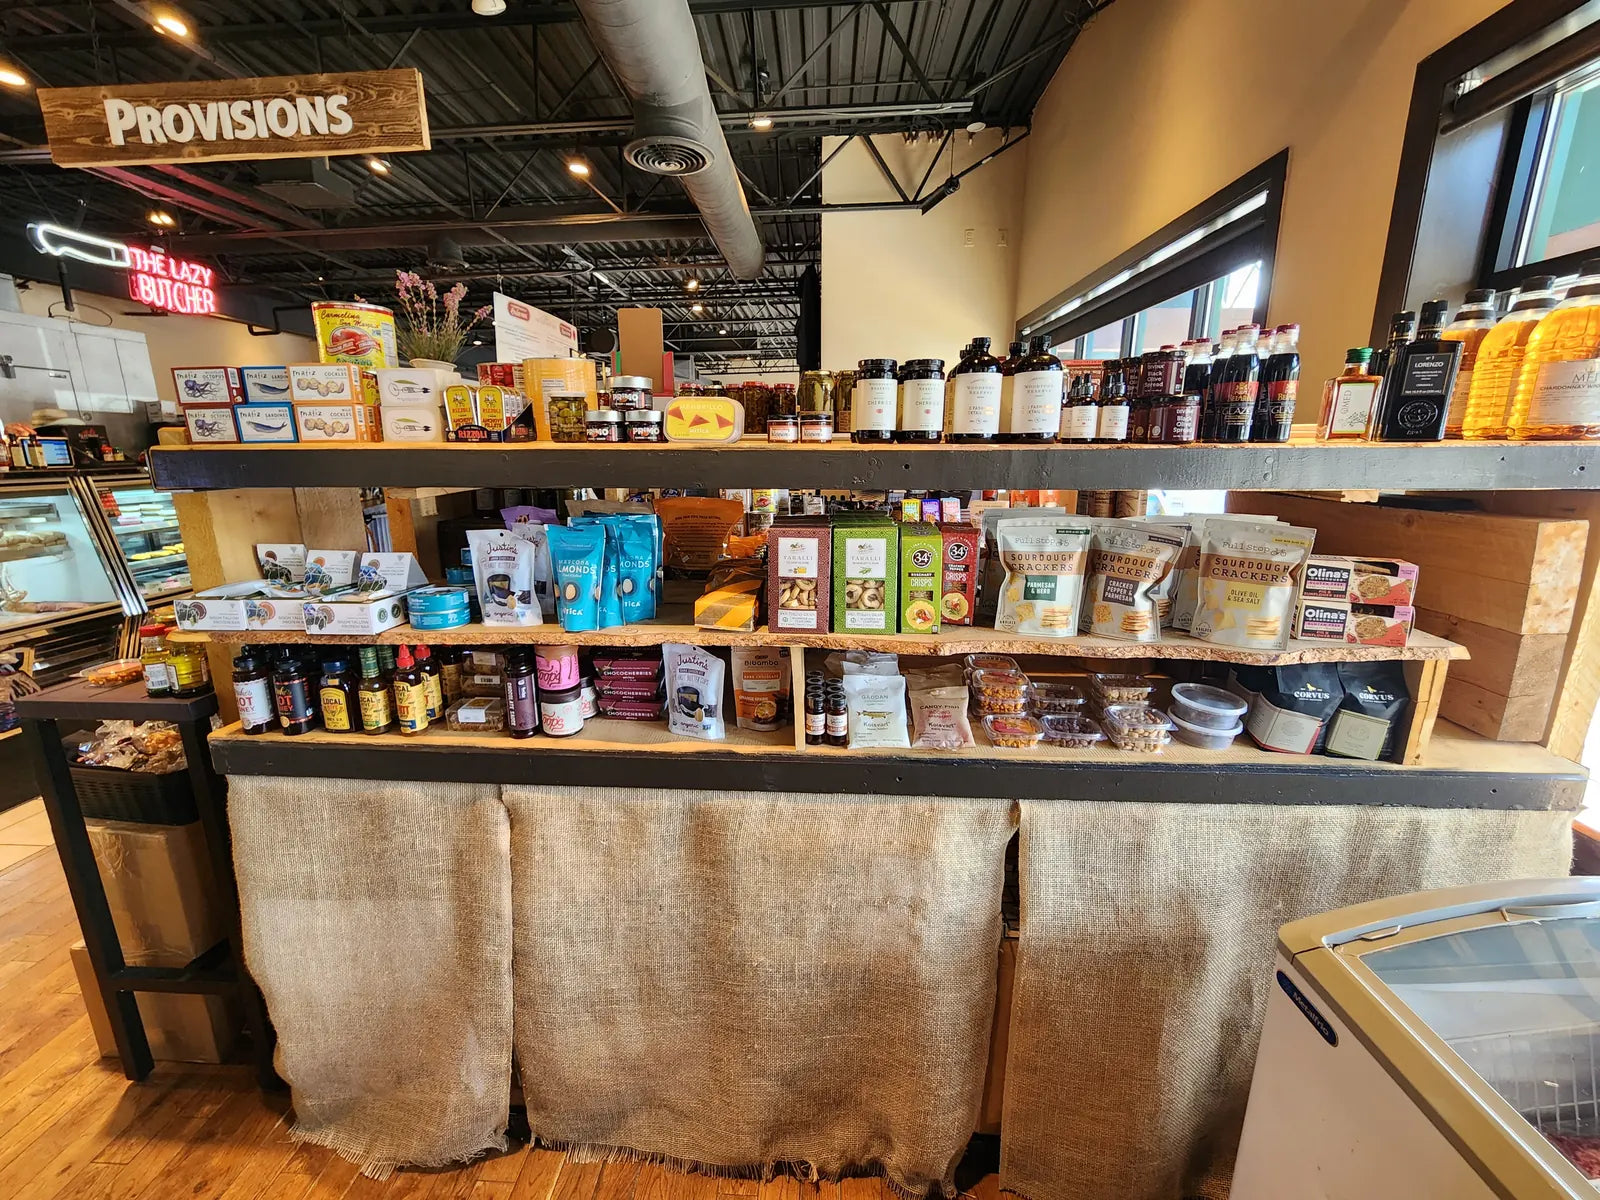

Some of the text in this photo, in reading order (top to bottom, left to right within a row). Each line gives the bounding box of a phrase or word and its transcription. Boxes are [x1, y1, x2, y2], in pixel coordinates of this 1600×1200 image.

[104, 94, 353, 146] PROVISIONS
[128, 246, 212, 287] THE LAZY
[136, 273, 216, 314] BUTCHER
[292, 368, 316, 377] matiz
[612, 393, 638, 401] PRIMO
[239, 410, 261, 418] matiz
[300, 409, 322, 417] matiz
[457, 430, 488, 439] RIZZOLI
[632, 427, 660, 435] PRIMO
[487, 541, 518, 555] Justin's
[1104, 538, 1124, 546] Full
[1125, 541, 1145, 552] Stop
[1222, 541, 1271, 554] Full Stop
[1010, 553, 1074, 562] SOURDOUGH
[1097, 553, 1162, 570] SOURDOUGH
[1011, 563, 1073, 572] CRACKERS
[1215, 558, 1290, 573] SOURDOUGH
[1095, 562, 1159, 580] CRACKERS
[1212, 567, 1288, 583] CRACKERS
[1307, 567, 1349, 579] Olina's
[945, 571, 967, 582] CRISPS
[910, 577, 933, 587] CRISPS
[1108, 580, 1134, 589] CRACKED
[1107, 585, 1128, 595] PEPPER
[1230, 589, 1248, 597] OLIVE
[1104, 591, 1133, 602] PARMESAN
[1247, 597, 1260, 605] SALT
[1305, 608, 1346, 620] Olina's
[677, 654, 709, 671] Justin's
[1293, 690, 1330, 700] CORVUS
[1358, 692, 1394, 701] CORVUS
[238, 696, 253, 706] OT
[279, 696, 293, 706] OT
[323, 698, 343, 706] LOCAL
[1292, 991, 1329, 1036] Metalfrio
